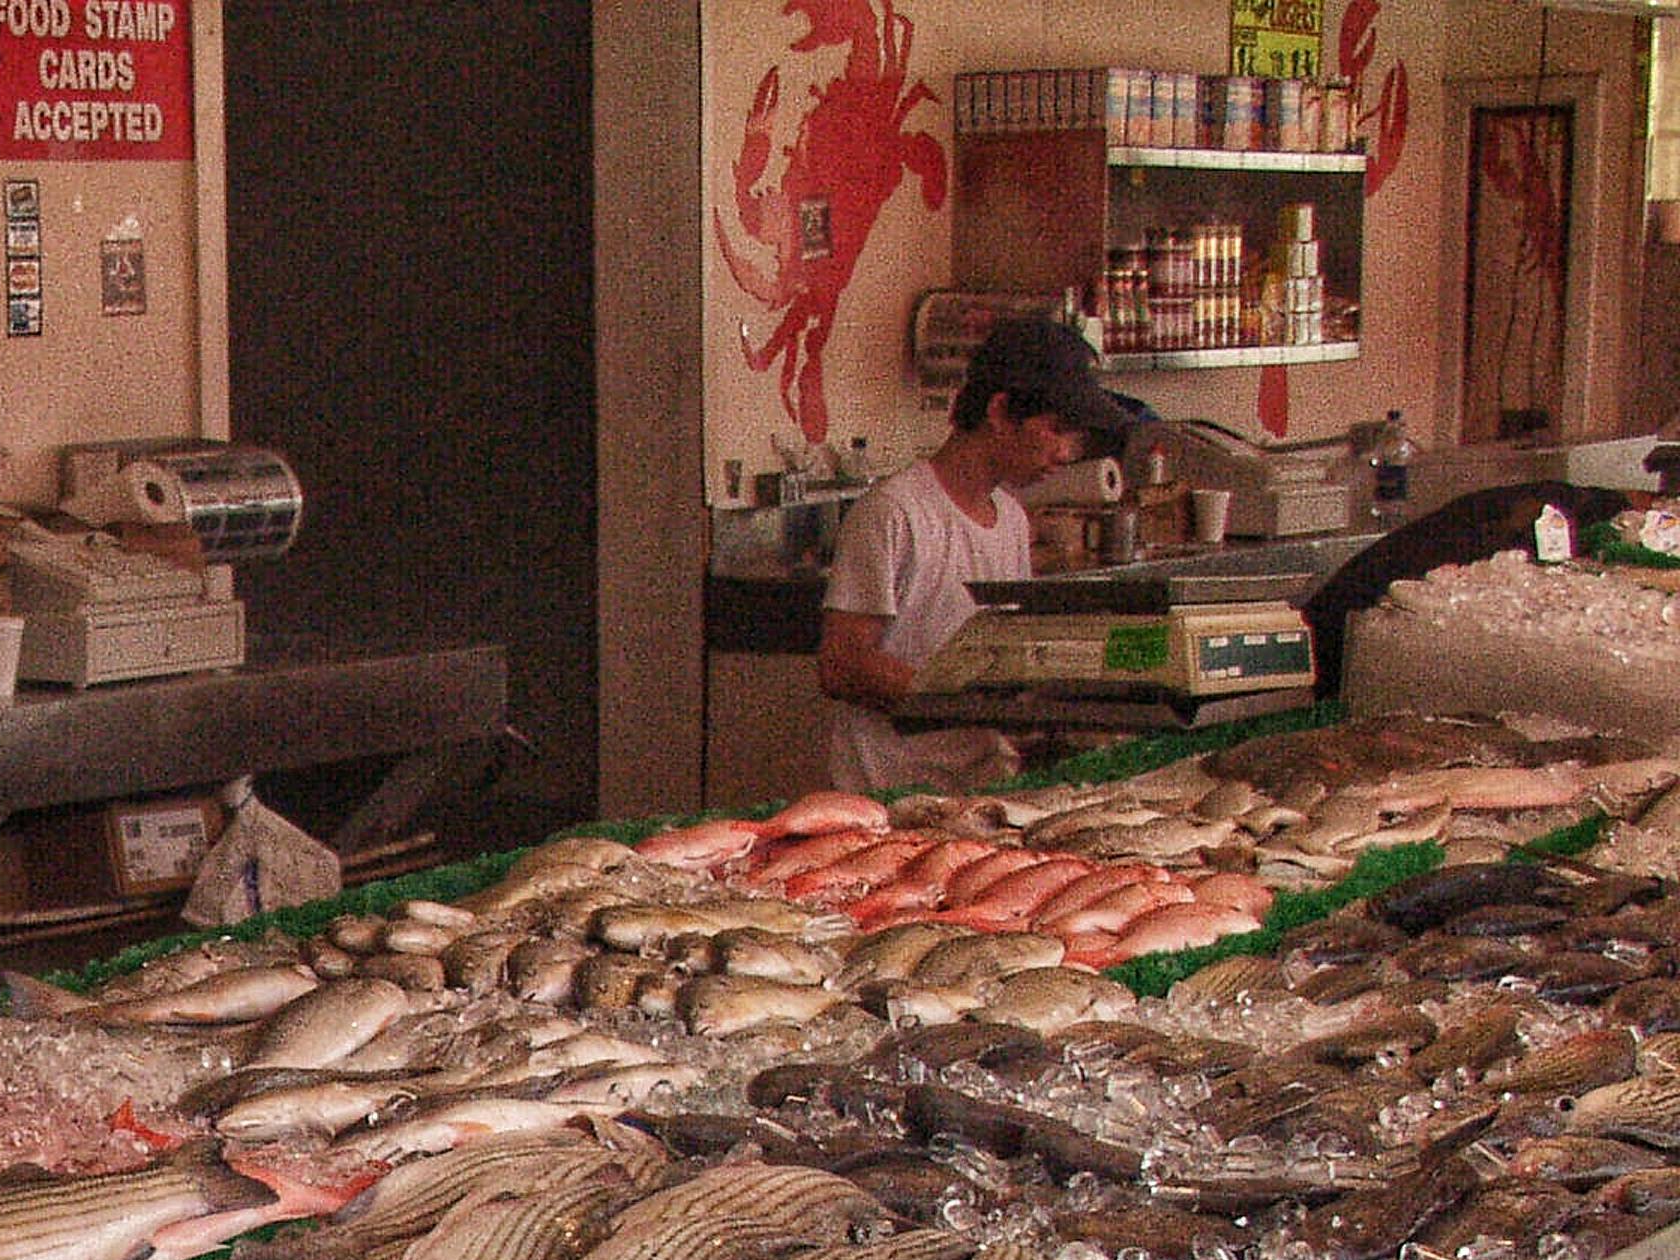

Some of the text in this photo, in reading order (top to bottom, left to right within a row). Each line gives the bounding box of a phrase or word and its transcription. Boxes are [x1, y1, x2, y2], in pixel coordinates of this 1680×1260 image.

[85, 0, 175, 41] STAMP
[39, 49, 136, 91] CARDS
[13, 100, 164, 142] ACCEPTED
